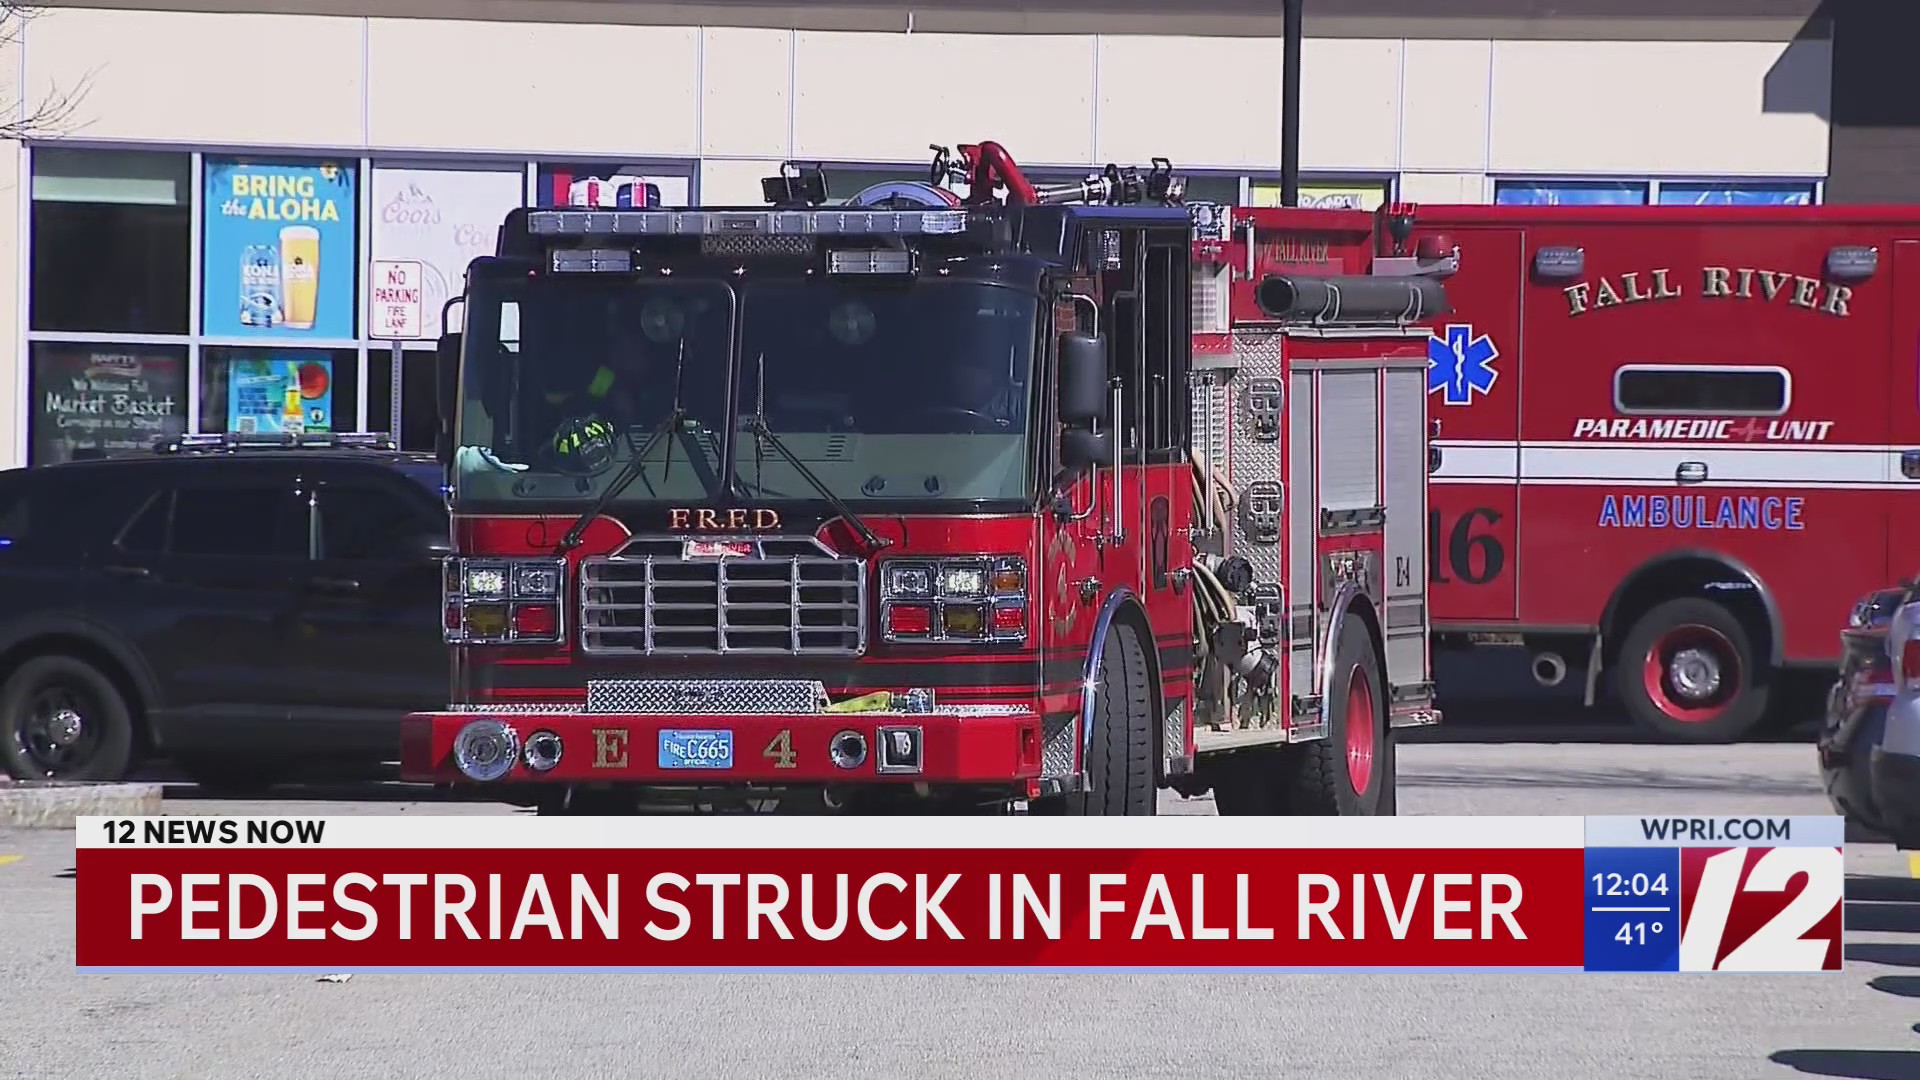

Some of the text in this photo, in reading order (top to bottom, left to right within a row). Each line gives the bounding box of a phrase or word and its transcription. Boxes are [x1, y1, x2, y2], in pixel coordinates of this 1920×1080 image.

[232, 175, 315, 198] BRING
[221, 198, 340, 221] the ALOHA
[382, 202, 441, 224] Coors
[388, 270, 406, 285] NO
[375, 288, 418, 303] PARKING
[1564, 266, 1853, 317] FALL RIVER
[387, 305, 406, 317] FIRE
[385, 317, 407, 329] LANE
[46, 391, 175, 416] Market Basket
[1573, 418, 1835, 441] PARAMEDIC UNIT
[1598, 494, 1805, 530] AMBULANCE
[1429, 507, 1505, 585] 16
[592, 729, 629, 769] E
[663, 738, 729, 760] FIRE C665
[762, 729, 798, 769] 4
